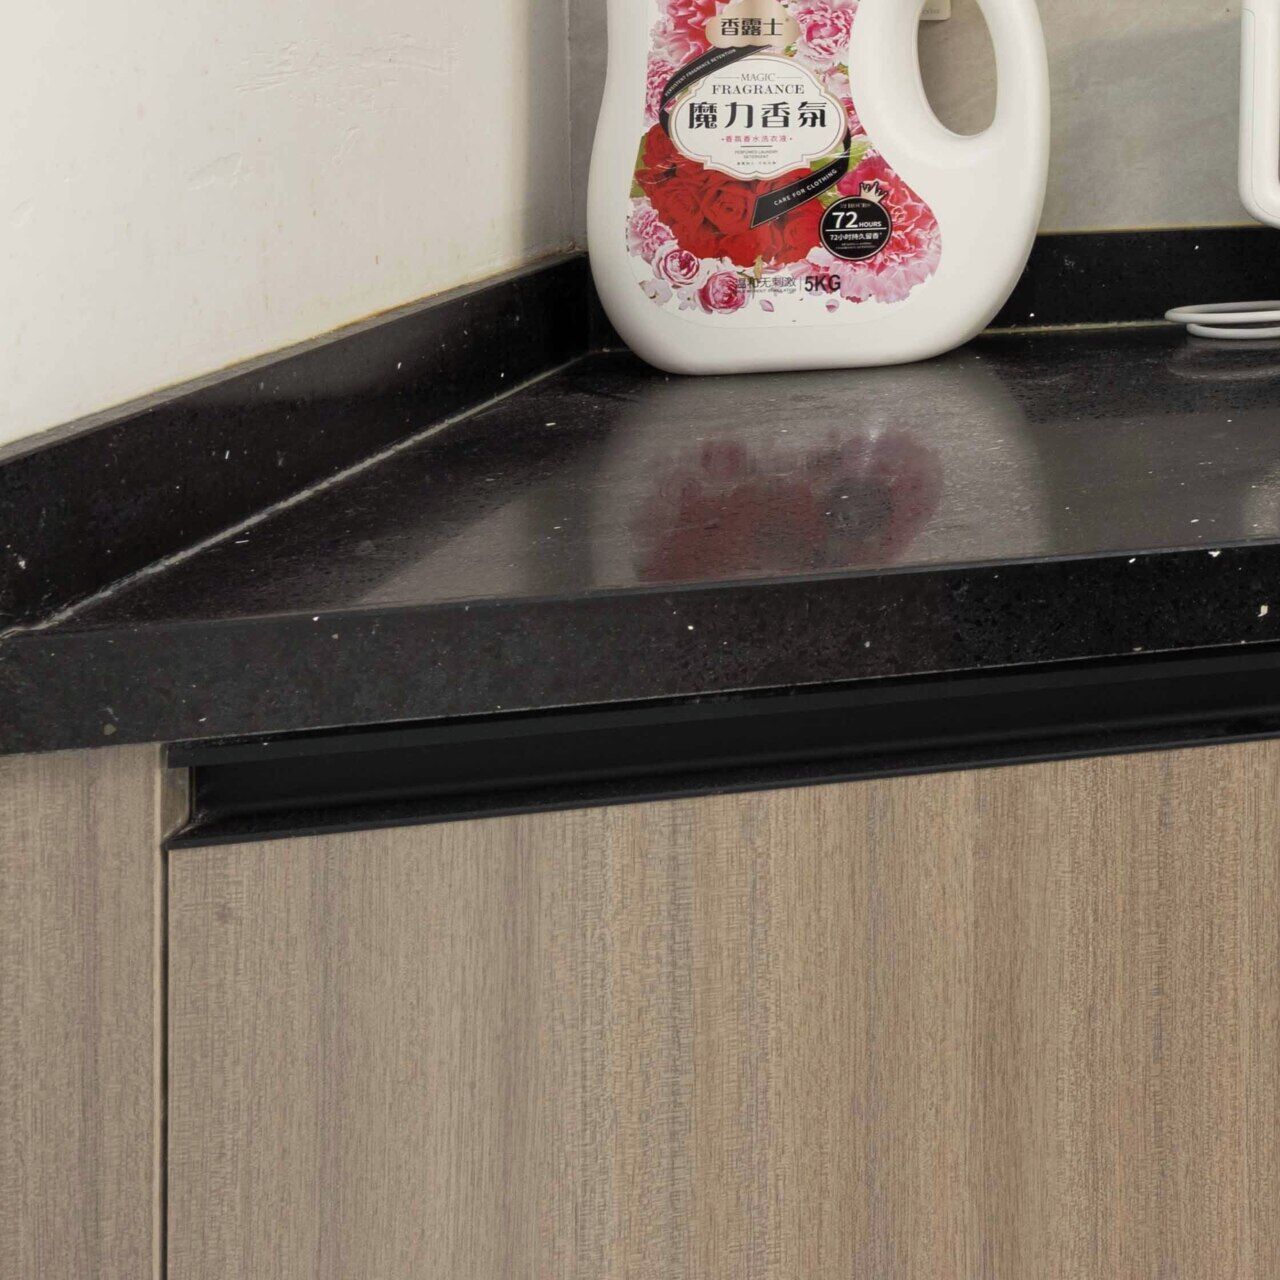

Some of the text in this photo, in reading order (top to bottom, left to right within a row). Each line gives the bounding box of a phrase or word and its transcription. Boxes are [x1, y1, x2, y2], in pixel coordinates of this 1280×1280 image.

[721, 18, 783, 36] 香露士
[741, 73, 776, 82] MAGIC
[712, 84, 805, 95] FRAGRANCE
[688, 101, 827, 130] 魔力香氛
[774, 169, 837, 205] CARE FOR CLOTHING
[832, 211, 858, 228] 72
[804, 274, 840, 292] 5KG
